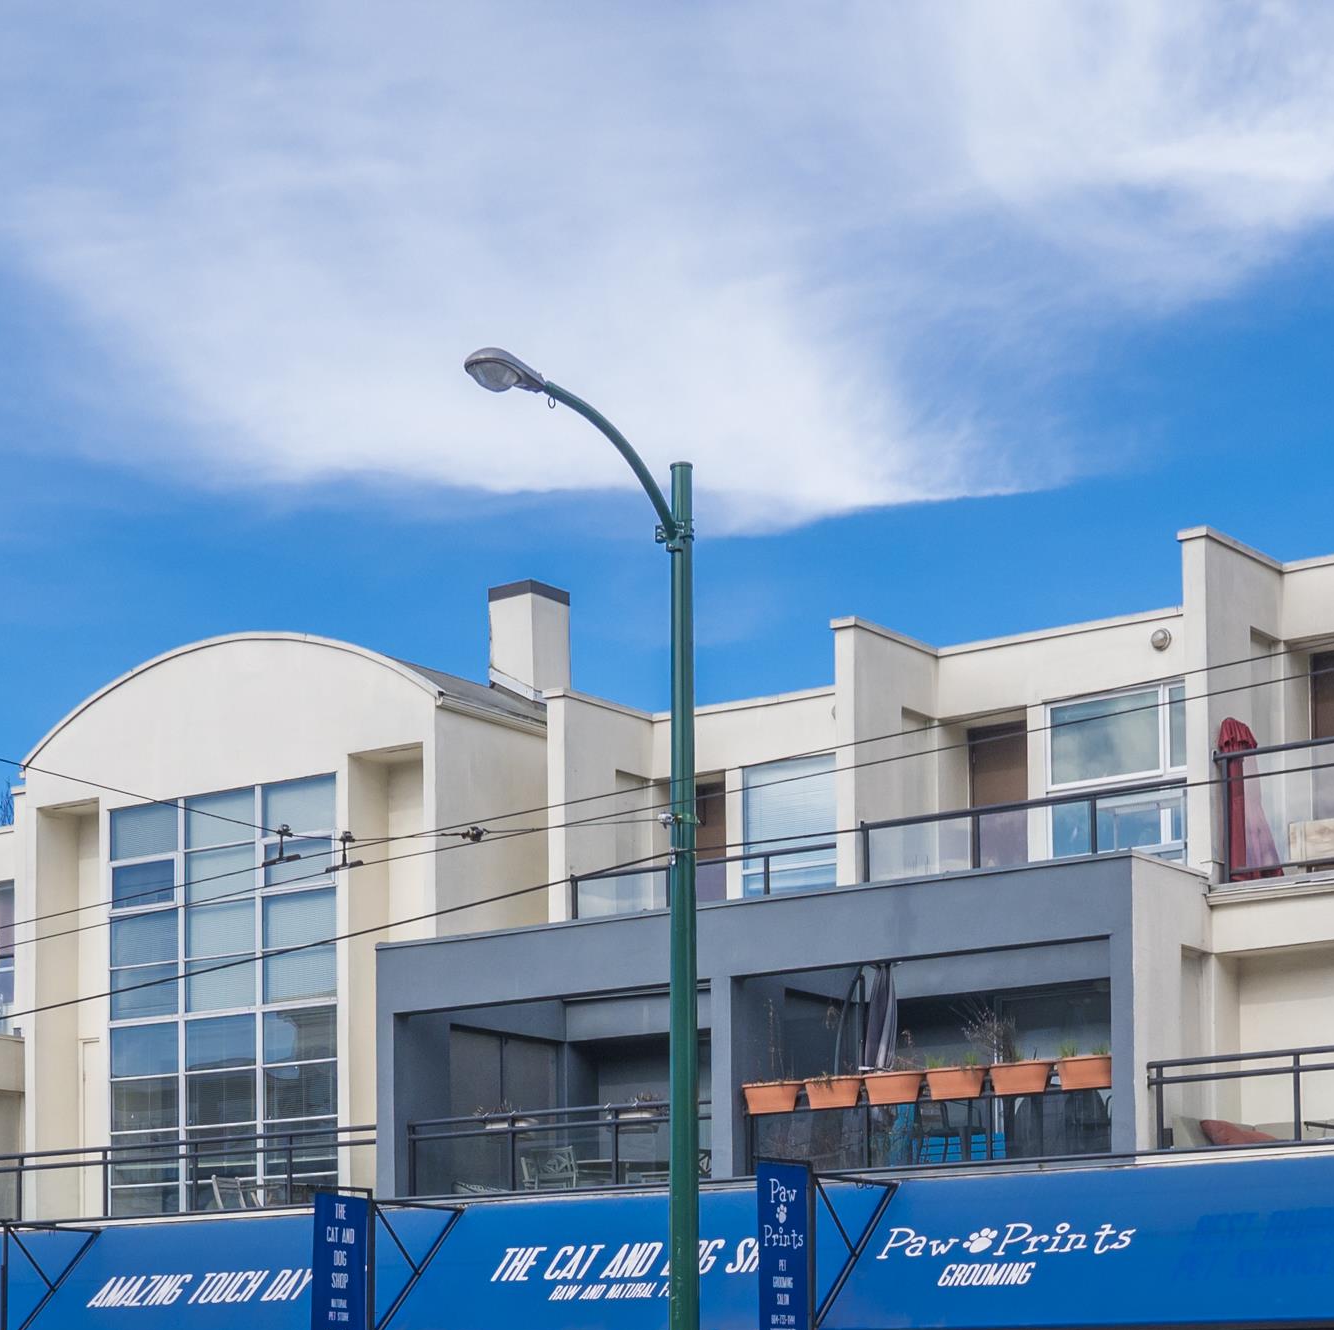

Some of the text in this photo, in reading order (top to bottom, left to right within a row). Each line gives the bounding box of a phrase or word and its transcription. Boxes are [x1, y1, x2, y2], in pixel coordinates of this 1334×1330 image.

[769, 1178, 797, 1203] Paw
[335, 1203, 346, 1220] THE
[326, 1226, 355, 1244] CAT AND
[764, 1225, 804, 1250] Prints
[876, 1227, 959, 1260] Paw
[993, 1222, 1136, 1256] Prints
[333, 1250, 347, 1266] DOG
[491, 1246, 547, 1281] THE
[544, 1244, 605, 1281] CAT
[599, 1241, 663, 1280] AND
[725, 1238, 759, 1273] SH
[331, 1273, 349, 1289] SHOP
[937, 1262, 1036, 1287] GROOMING
[86, 1268, 313, 1308] AMAZING TOUCH DAY
[548, 1285, 581, 1301] RAW
[580, 1284, 606, 1300] AND
[605, 1282, 657, 1300] NATURAL
